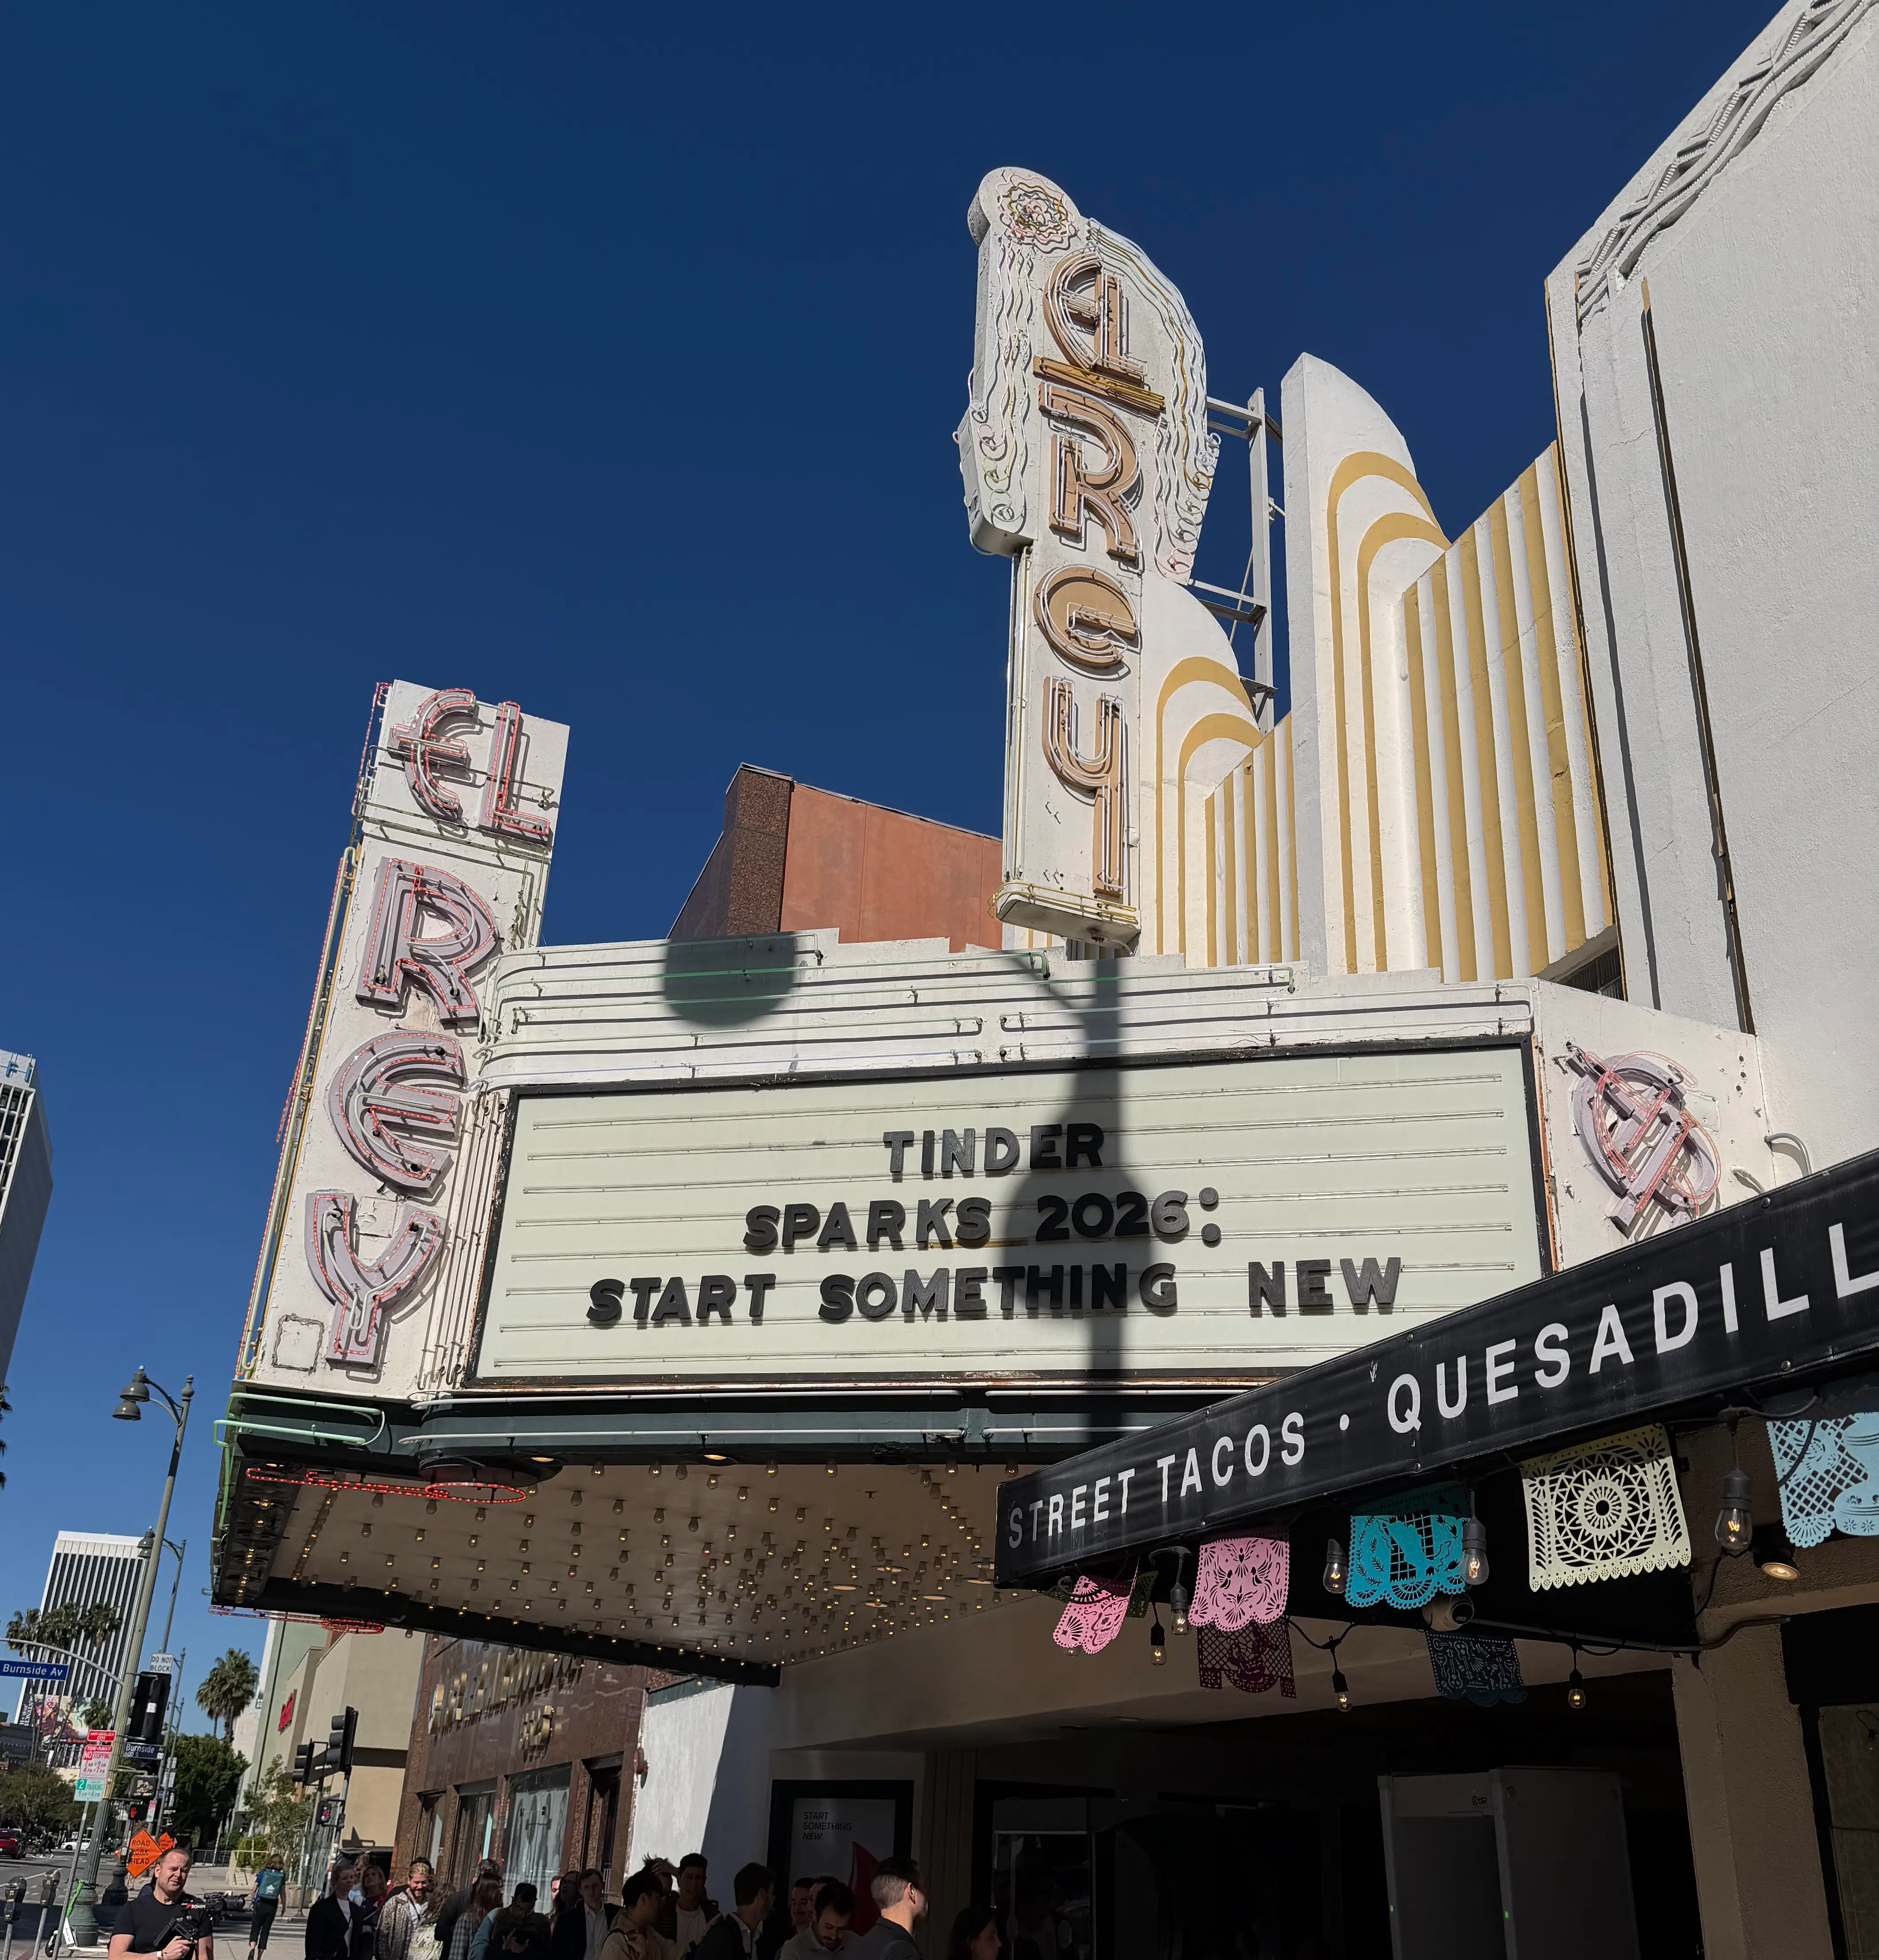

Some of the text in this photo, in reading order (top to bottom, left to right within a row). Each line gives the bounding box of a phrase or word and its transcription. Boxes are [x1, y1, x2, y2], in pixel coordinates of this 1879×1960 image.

[883, 1123, 1104, 1173] TINDER
[743, 1187, 1221, 1247] SPARKS 2026:
[586, 1257, 1401, 1322] START SOMETHING NEW
[1008, 1222, 1879, 1549] STREET TACOS QUESADILL
[3, 1664, 63, 1677] Burnside Av
[126, 1744, 155, 1753] Burnside
[79, 1779, 84, 1789] 2
[804, 1811, 829, 1820] START
[803, 1822, 852, 1830] SOMETHING
